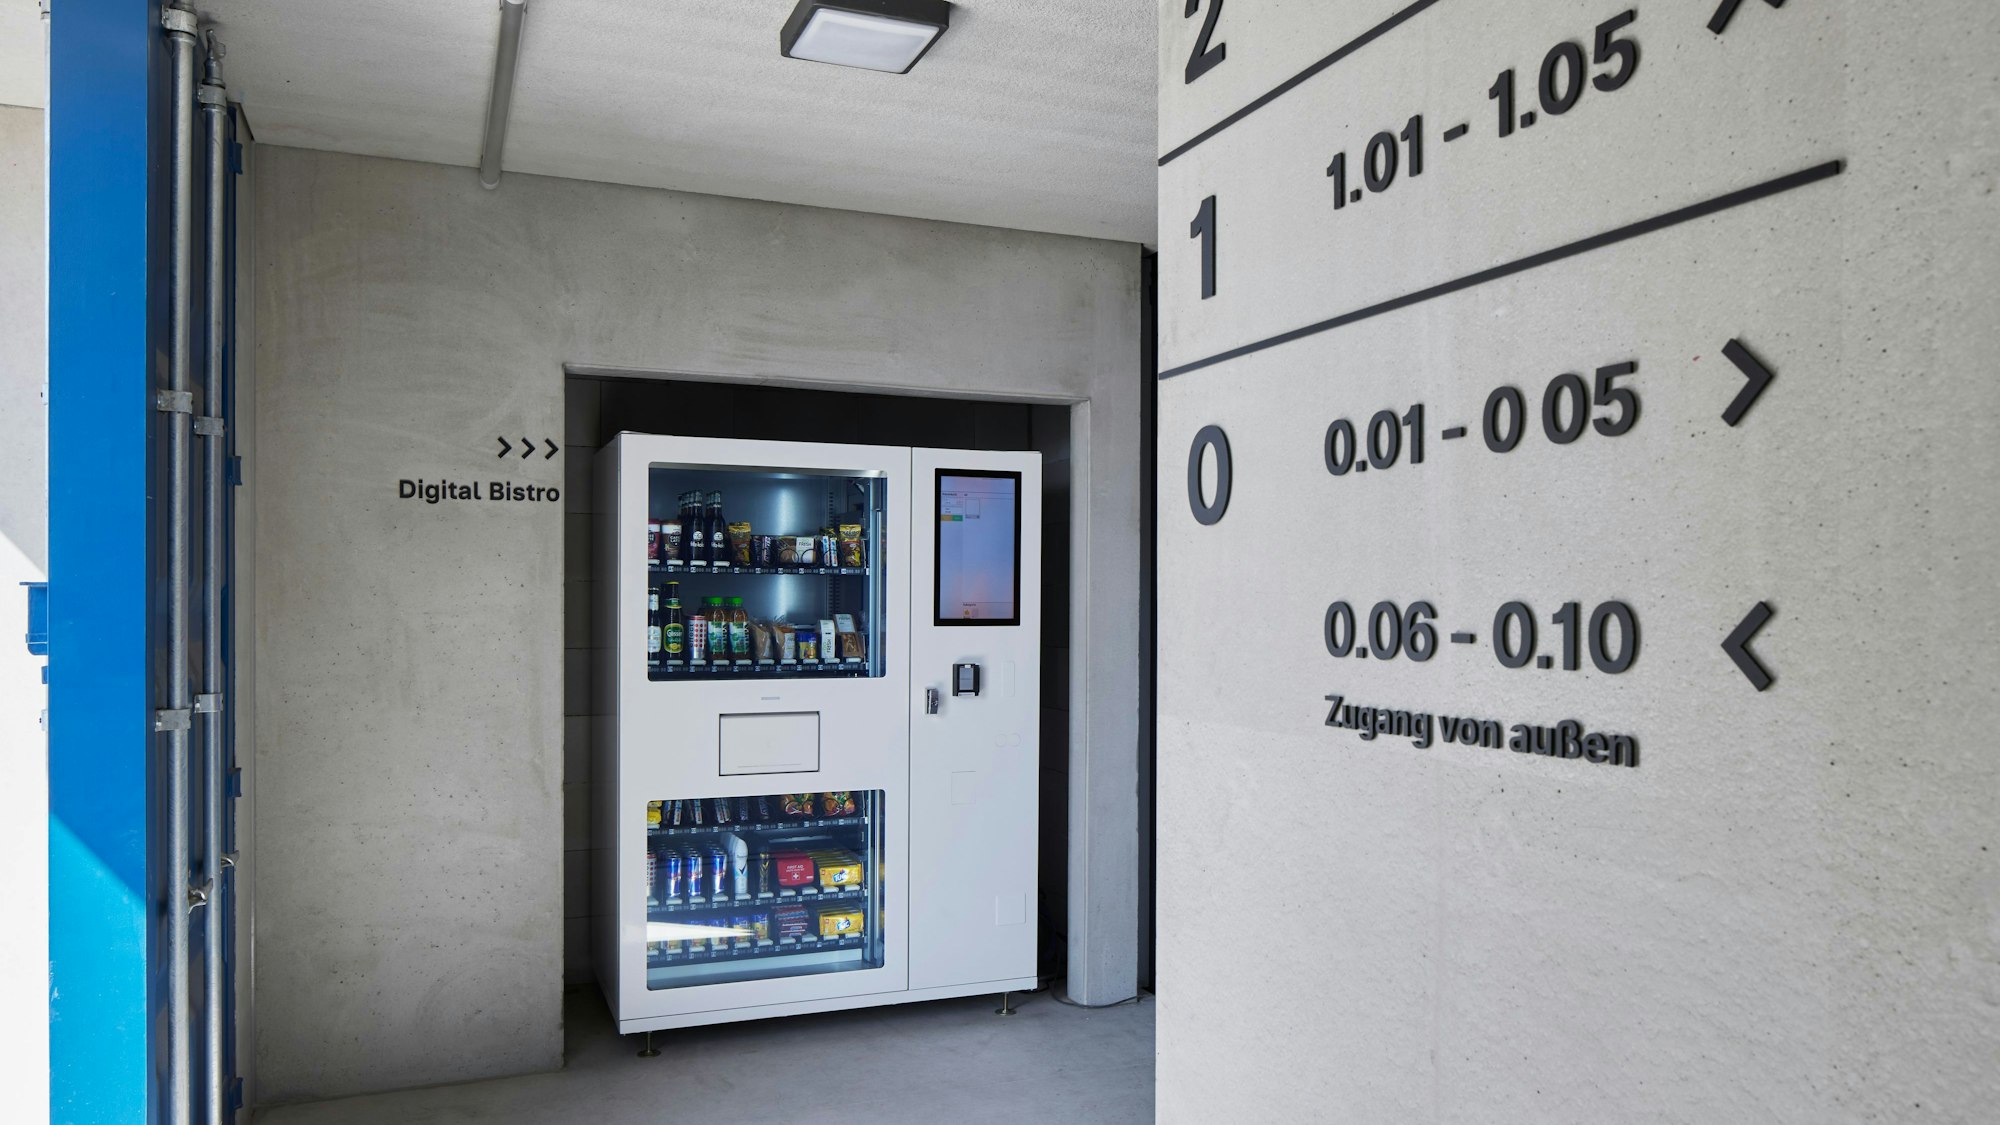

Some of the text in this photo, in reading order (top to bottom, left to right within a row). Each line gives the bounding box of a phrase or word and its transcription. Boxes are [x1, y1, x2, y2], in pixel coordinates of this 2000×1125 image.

[1185, 0, 1226, 85] 2
[1326, 115, 1423, 209] 1.01
[1489, 9, 1640, 137] 1.05
[1190, 195, 1217, 300] 1
[1187, 425, 1233, 526] 0
[1324, 403, 1425, 476] 0.01
[399, 479, 560, 504] Digital Bistro
[1324, 601, 1438, 662] 0.06
[1493, 601, 1641, 674] 0.10
[1324, 695, 1640, 767] Zugang von außen
[834, 873, 847, 882] TUC
